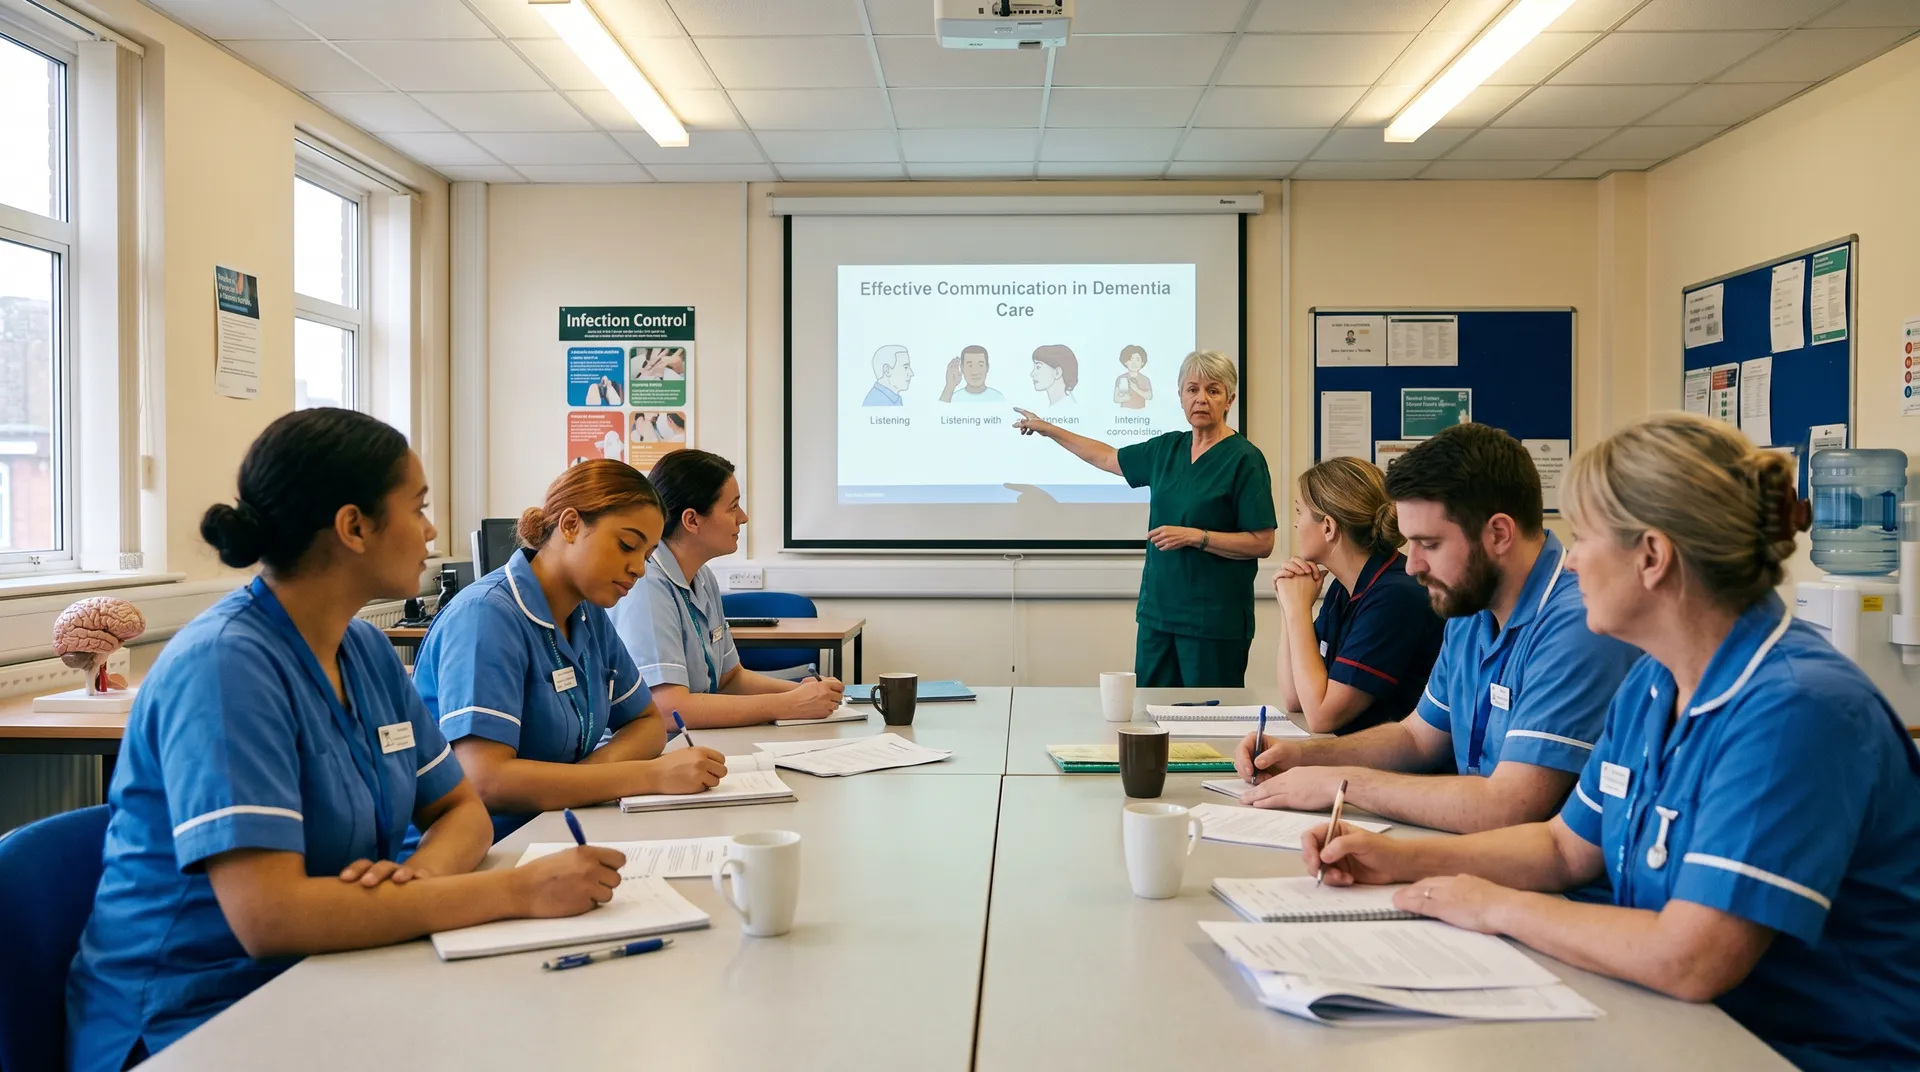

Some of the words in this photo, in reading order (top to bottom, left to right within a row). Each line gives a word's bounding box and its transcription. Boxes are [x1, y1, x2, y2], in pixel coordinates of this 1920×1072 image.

[860, 281, 933, 296] Effective
[937, 281, 1067, 296] Communication
[1072, 280, 1088, 295] in
[1093, 280, 1171, 296] Dementia
[996, 303, 1035, 317] Care
[566, 313, 630, 328] Infection
[633, 313, 687, 327] Control
[869, 415, 911, 427] Listening
[940, 415, 981, 427] Listening
[983, 415, 1002, 425] with
